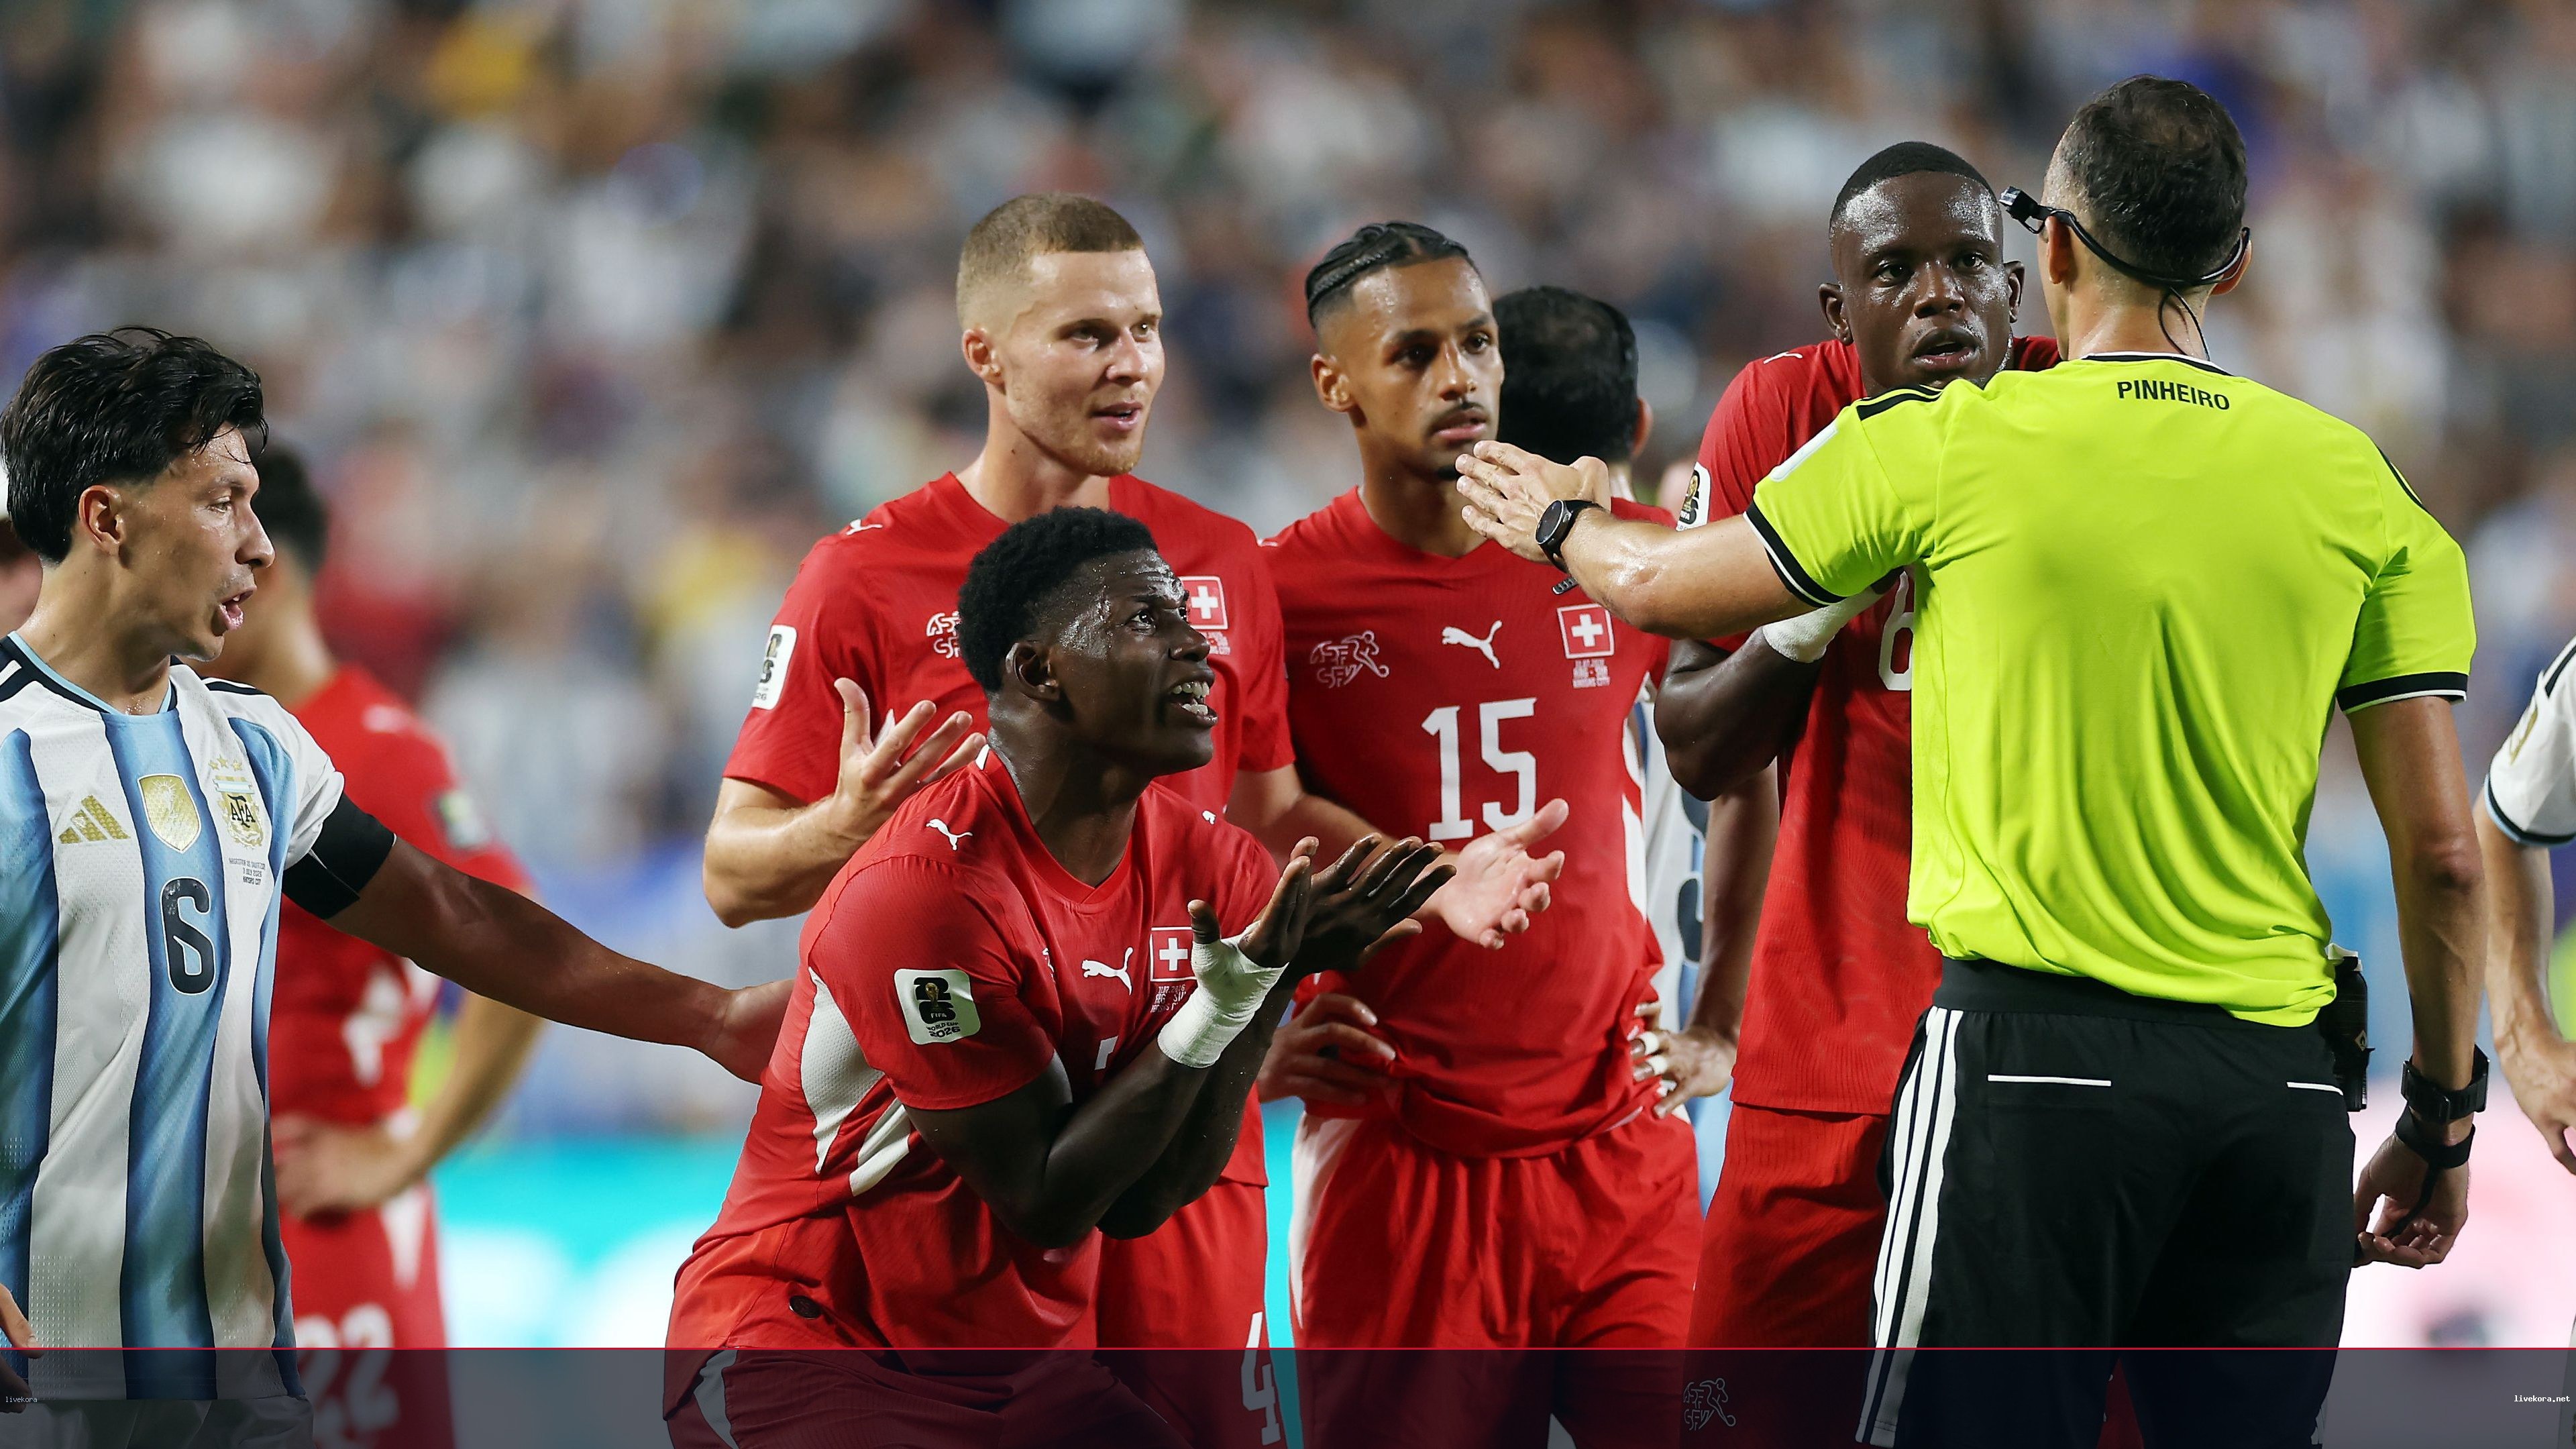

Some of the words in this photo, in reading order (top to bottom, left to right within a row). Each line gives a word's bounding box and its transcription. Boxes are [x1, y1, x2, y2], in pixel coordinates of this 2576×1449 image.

[2116, 379, 2230, 411] PINHEIRO
[1421, 697, 1538, 841] 15
[227, 794, 256, 828] AFA
[160, 876, 216, 996] 6
[929, 1026, 961, 1038] 2026
[1241, 1311, 1281, 1446] 4
